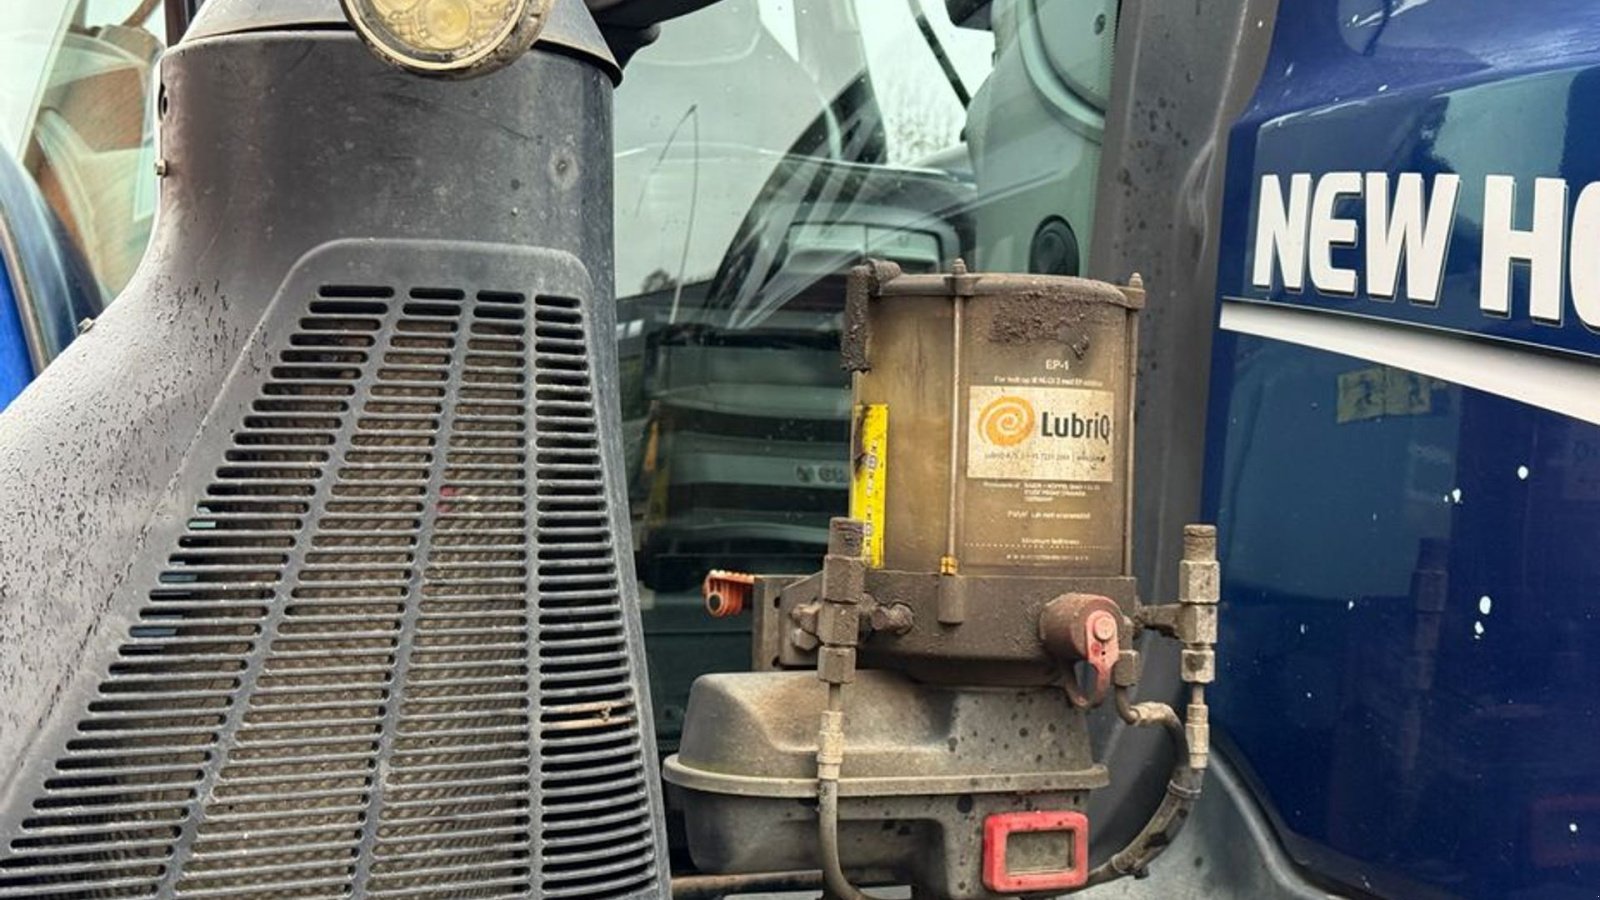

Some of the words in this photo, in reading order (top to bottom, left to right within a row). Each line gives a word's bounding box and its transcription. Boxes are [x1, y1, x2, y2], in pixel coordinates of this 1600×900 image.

[1253, 172, 1460, 306] NEW
[1045, 359, 1070, 371] EP-1
[1042, 411, 1111, 446] LubriQ
